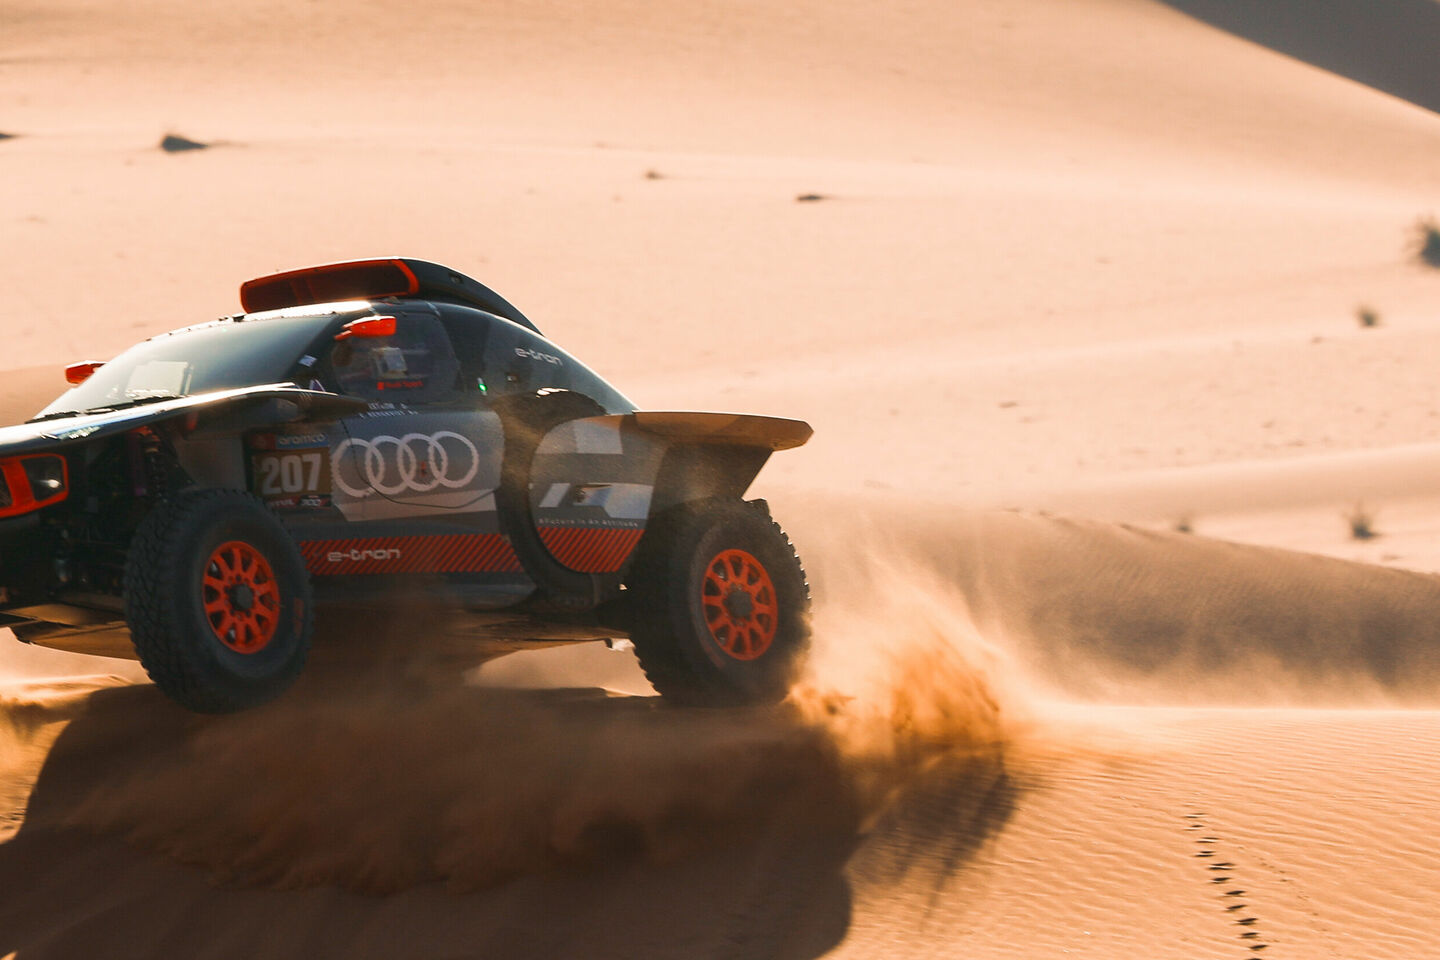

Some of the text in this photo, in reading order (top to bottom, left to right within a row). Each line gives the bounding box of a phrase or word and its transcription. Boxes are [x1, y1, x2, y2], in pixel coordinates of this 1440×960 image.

[514, 347, 563, 366] e-tron
[279, 432, 326, 445] aramco
[262, 453, 321, 495] 207
[327, 548, 401, 562] e-tron
